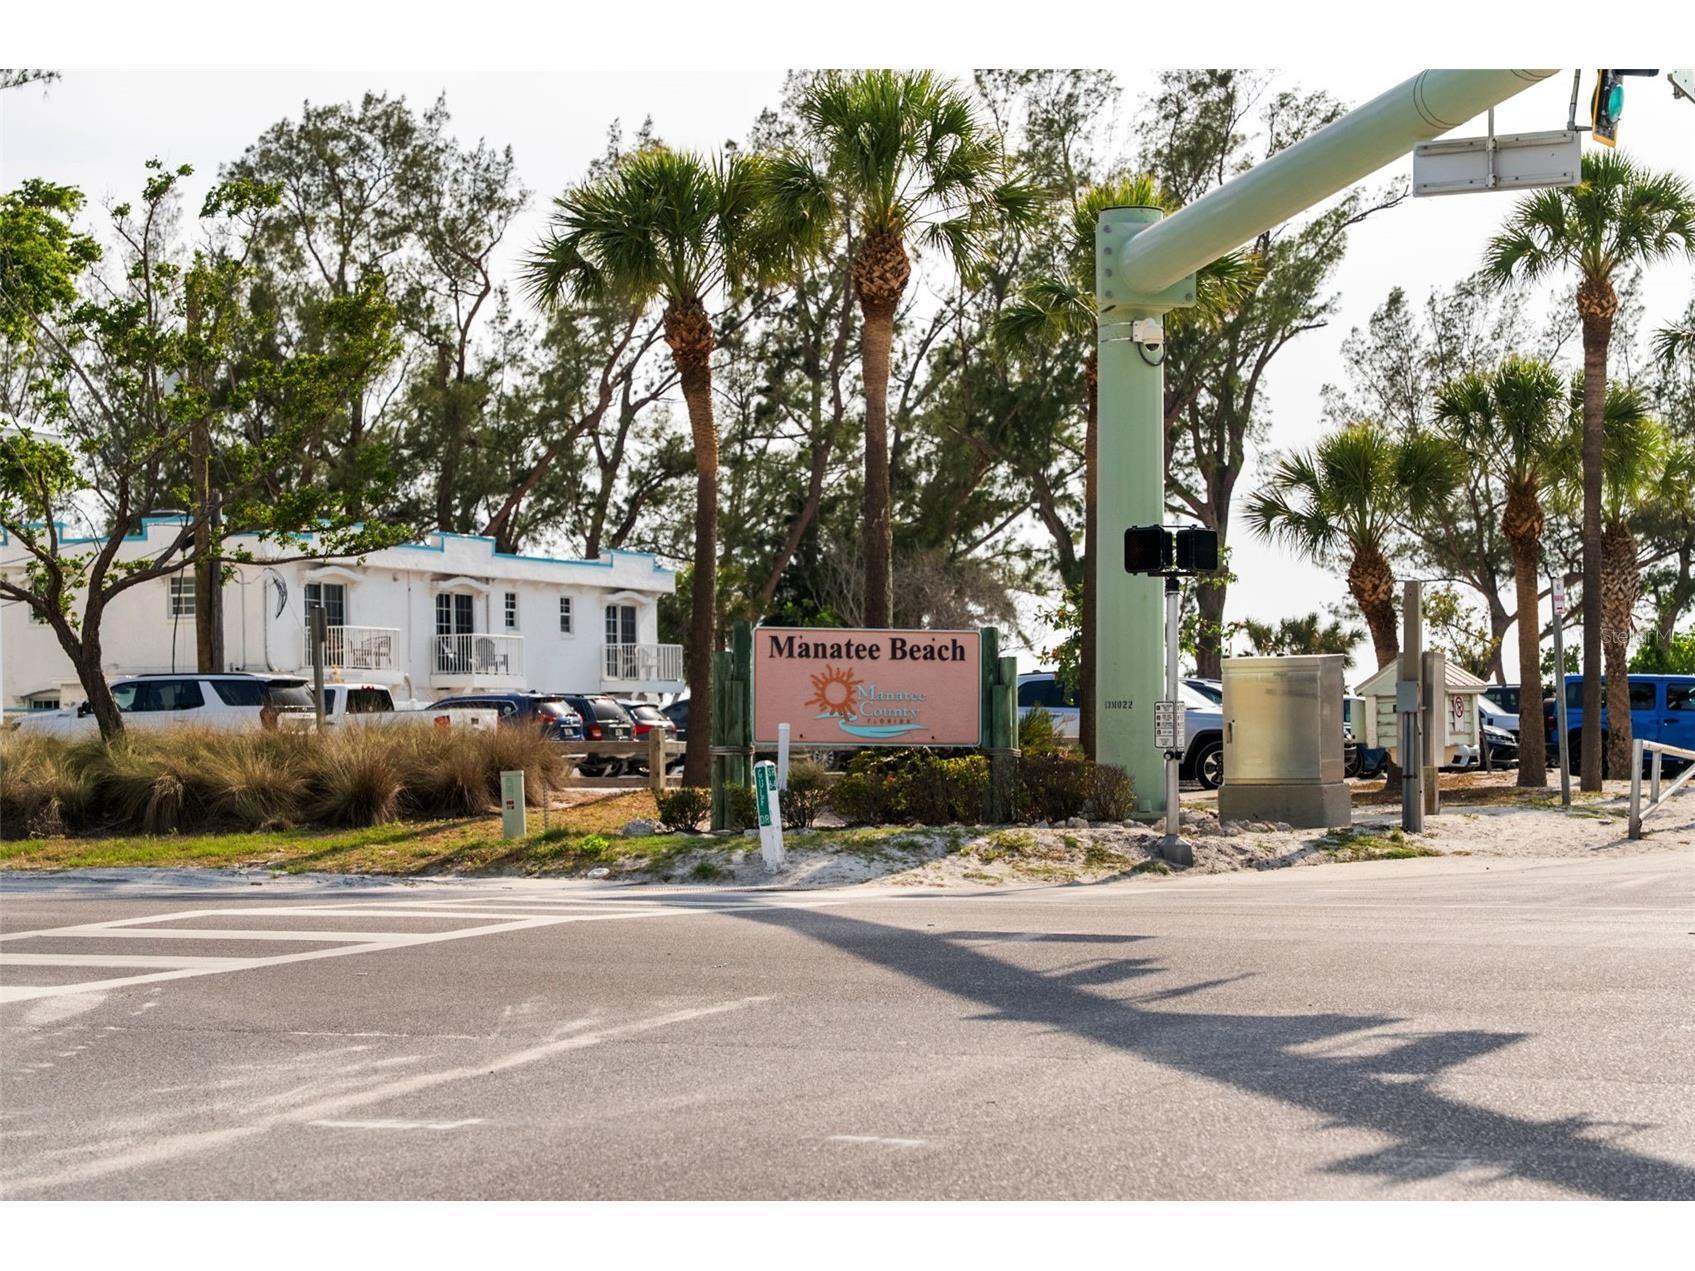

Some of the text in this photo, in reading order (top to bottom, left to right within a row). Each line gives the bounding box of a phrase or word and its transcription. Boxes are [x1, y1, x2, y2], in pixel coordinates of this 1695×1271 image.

[768, 635, 966, 662] Manatee Beach
[856, 685, 927, 701] Manatee
[860, 701, 919, 718] County
[760, 815, 770, 825] DR
